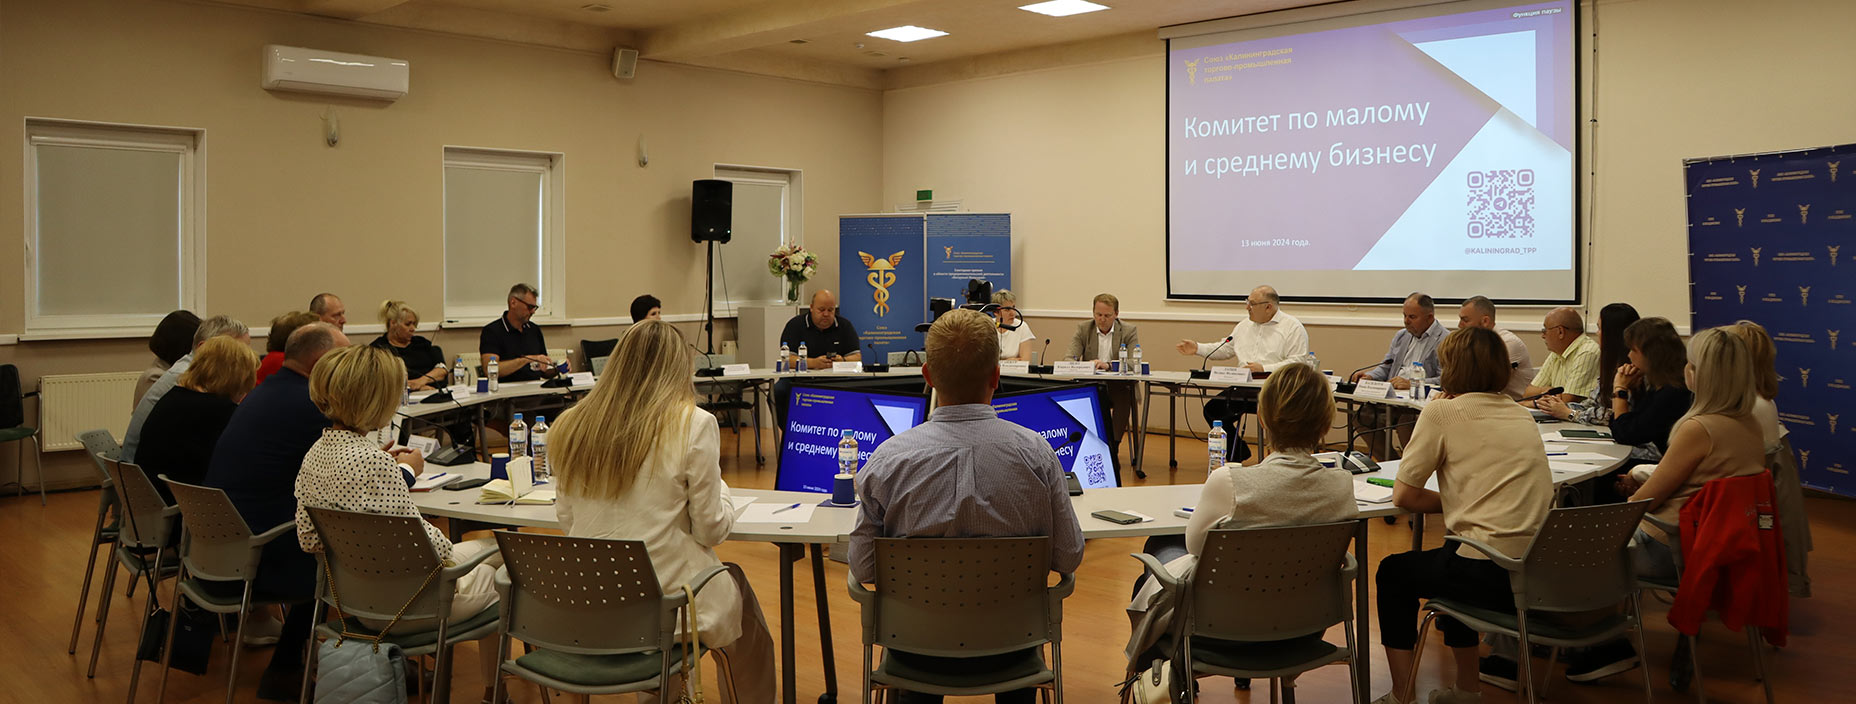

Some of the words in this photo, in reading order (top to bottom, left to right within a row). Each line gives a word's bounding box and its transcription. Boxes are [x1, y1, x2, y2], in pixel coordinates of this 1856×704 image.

[1185, 114, 1280, 138] Комитет
[1288, 112, 1318, 130] по
[1326, 102, 1430, 127] малому
[1185, 159, 1197, 175] и
[1205, 150, 1322, 179] среднему
[1329, 142, 1437, 167] бизнесу
[1272, 238, 1290, 246] 2024
[1464, 248, 1537, 256] @KALININGRAD_TPP
[790, 420, 826, 436] Комитет
[827, 428, 839, 437] по
[788, 442, 794, 450] и
[795, 442, 838, 458] среднему
